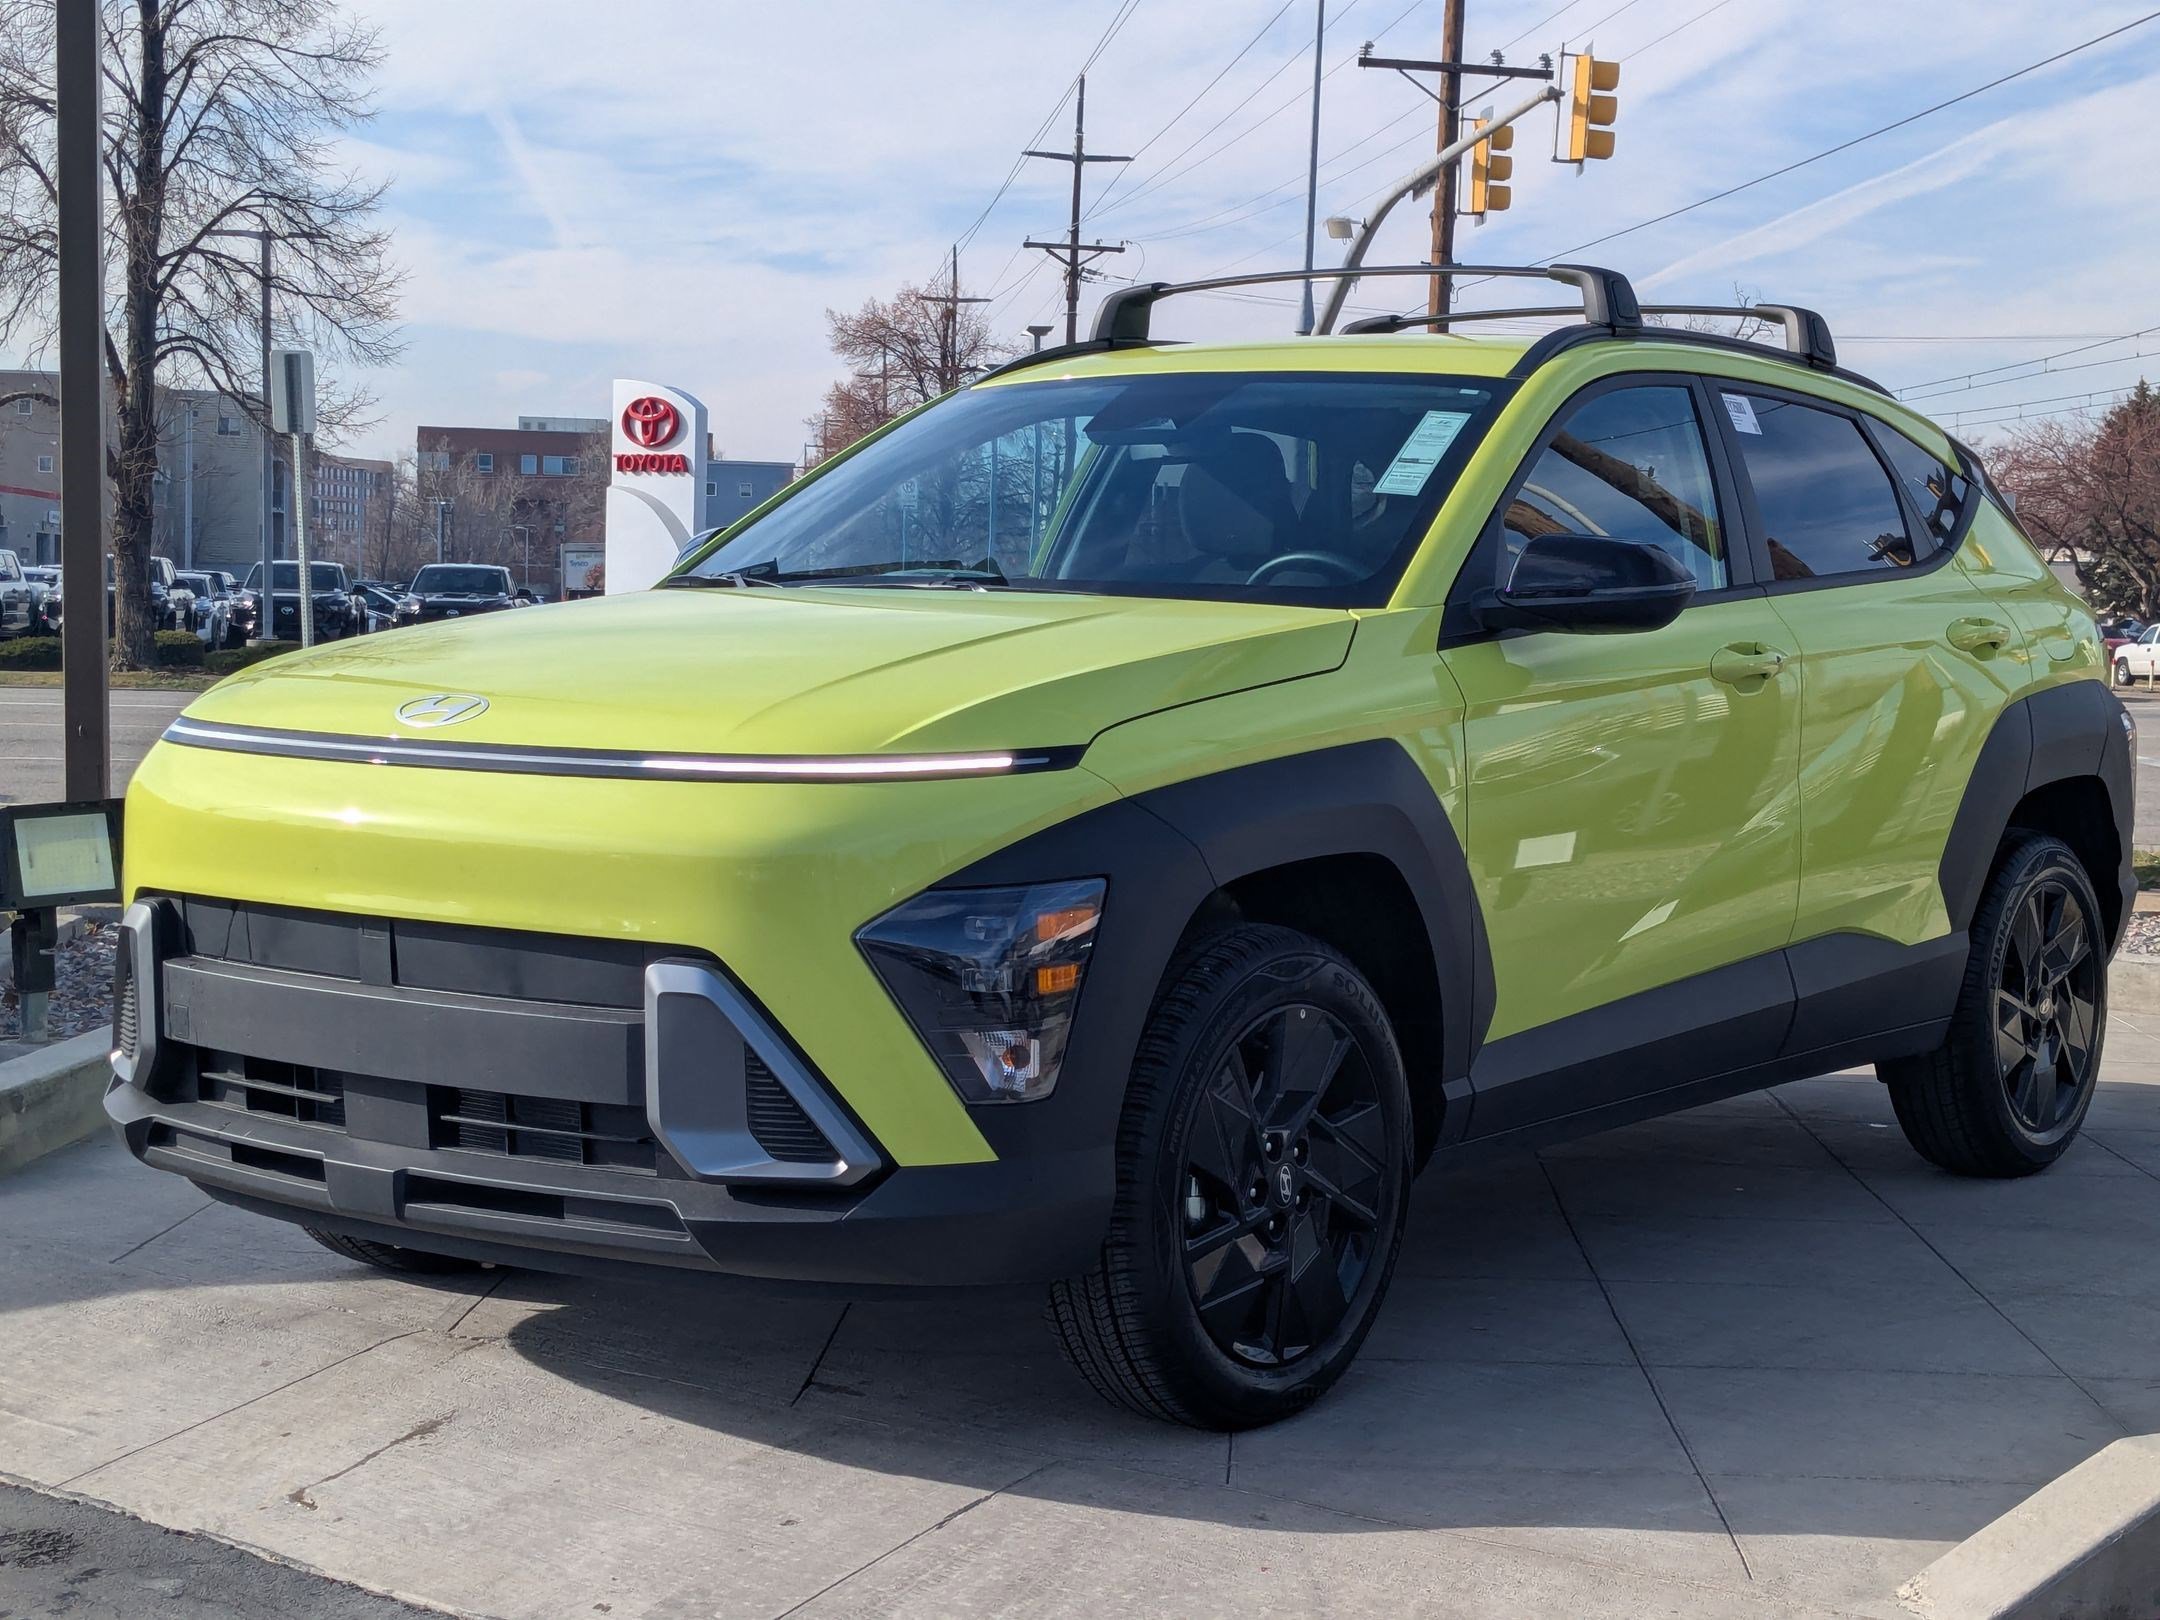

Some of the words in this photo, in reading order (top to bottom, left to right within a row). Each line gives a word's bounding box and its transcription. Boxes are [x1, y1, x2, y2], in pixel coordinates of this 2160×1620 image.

[612, 454, 689, 473] TOYOTA
[1990, 906, 2014, 990] KUMHO
[1333, 972, 1389, 1036] SOLUS
